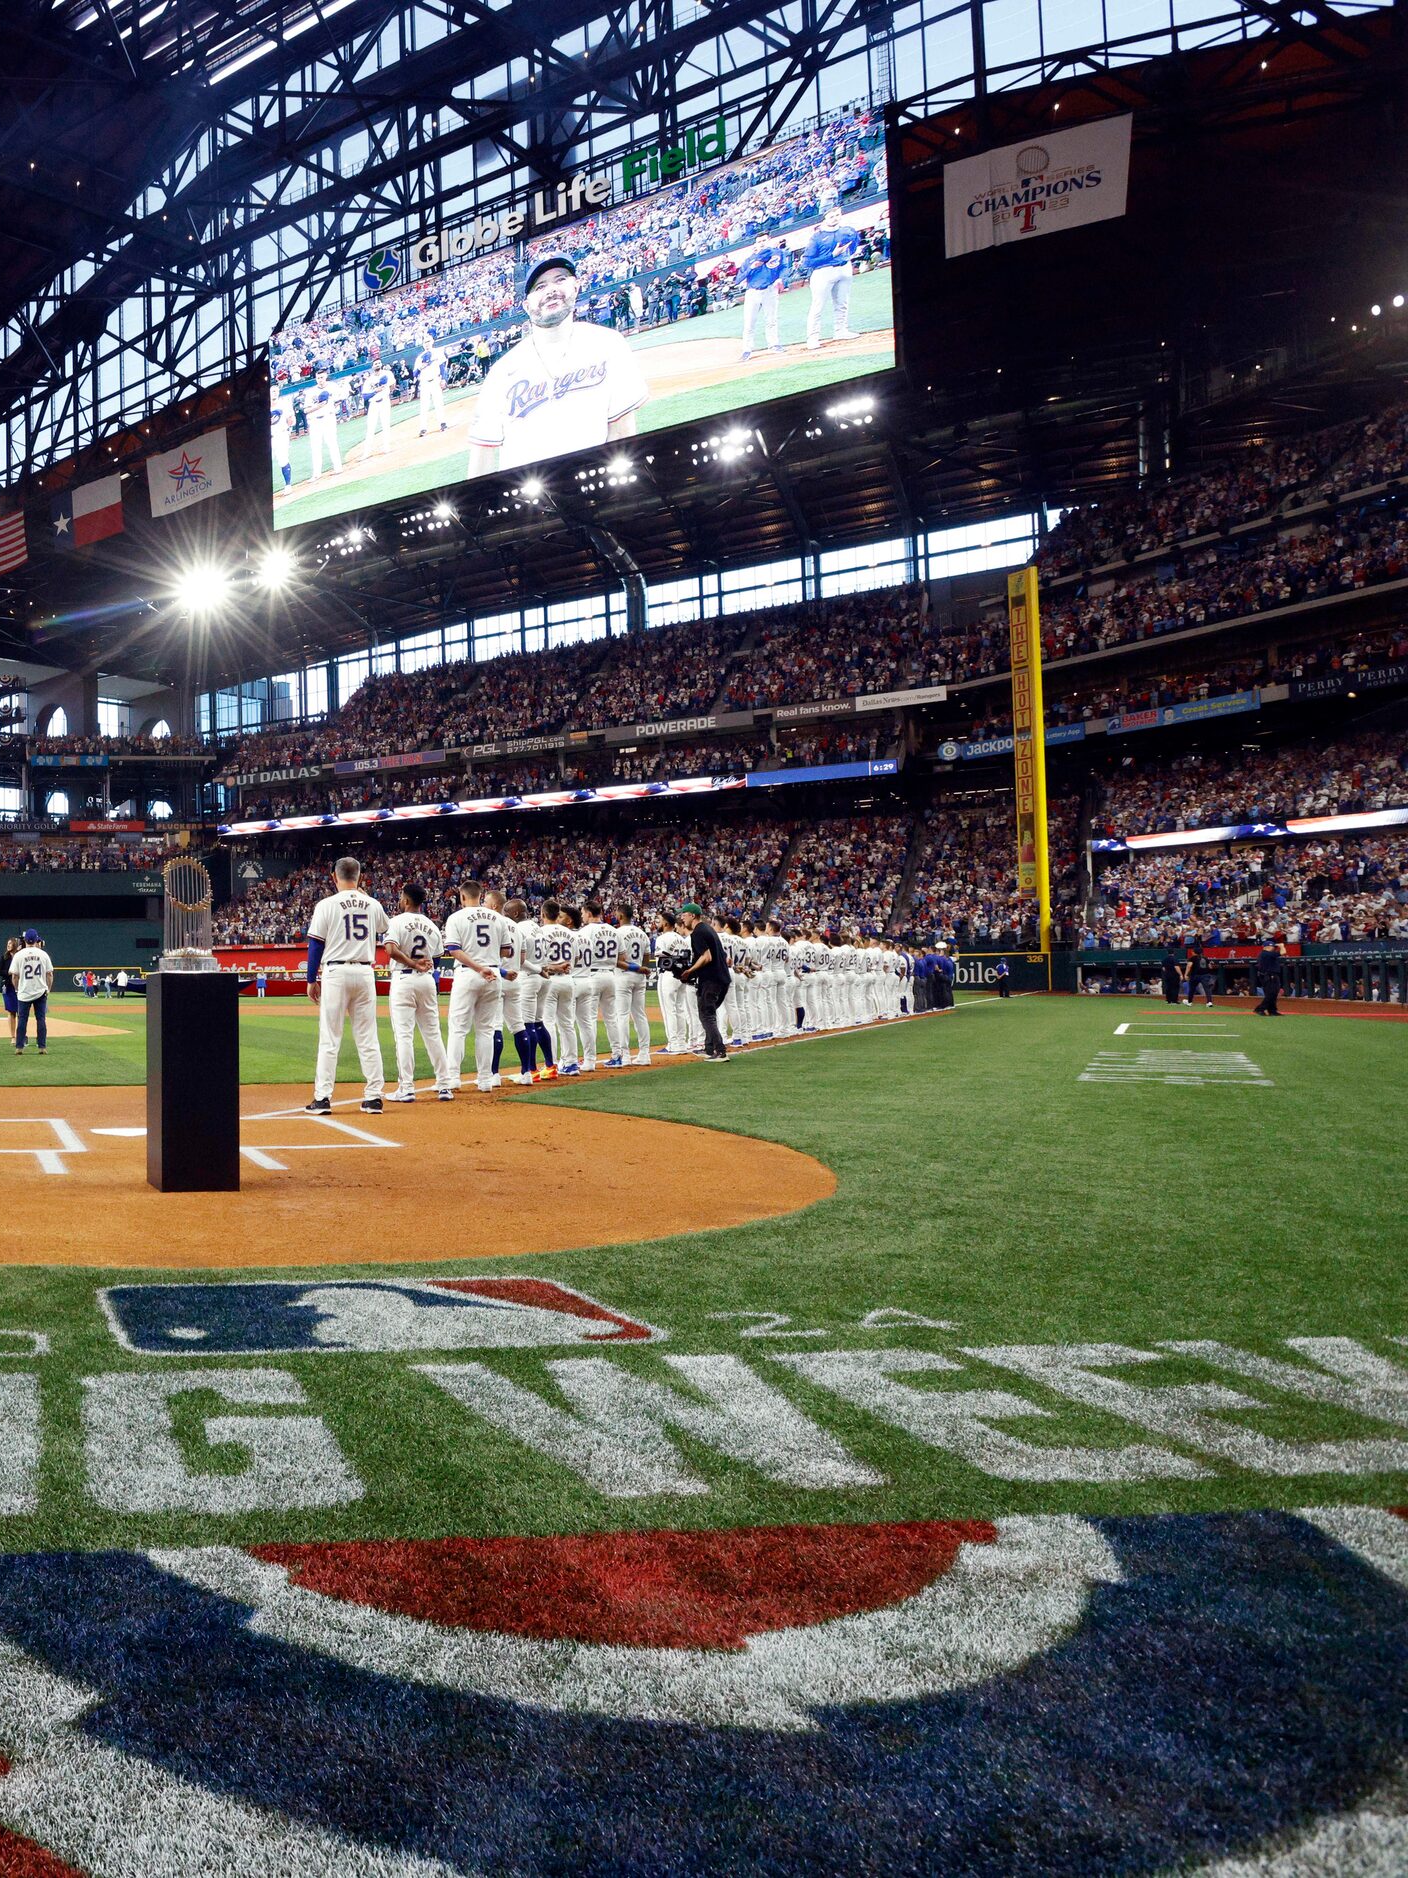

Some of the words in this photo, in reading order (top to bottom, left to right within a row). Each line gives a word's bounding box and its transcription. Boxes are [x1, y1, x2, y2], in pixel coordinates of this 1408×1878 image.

[974, 183, 1020, 201] WORLD
[1045, 164, 1095, 184] SERIES
[411, 209, 525, 271] Globe
[534, 176, 611, 226] Life
[621, 117, 727, 192] Field
[967, 169, 1102, 218] CHAMPIONS
[1048, 197, 1070, 211] 23
[506, 357, 609, 420] Rangers
[164, 480, 213, 507] ARLINGTON
[1015, 607, 1025, 660] THE
[1357, 665, 1408, 683] PERRY
[1298, 677, 1344, 693] PERRY
[776, 708, 798, 718] Real
[799, 705, 820, 715] fans
[821, 701, 852, 712] know.
[1017, 675, 1027, 727] HOT
[1121, 711, 1158, 722] BAKER
[635, 715, 716, 738] POWERADE
[1067, 728, 1081, 737] App
[472, 743, 501, 755] PGL
[353, 759, 379, 771] 105.3
[873, 763, 894, 772] 6:29
[236, 774, 258, 786] UT
[260, 765, 321, 783] DALLAS
[1020, 742, 1030, 812] ZONE
[33, 822, 58, 831] GOLD
[156, 823, 203, 831] PLUCKERS
[339, 898, 371, 911] BOCHY
[466, 912, 497, 924] SEAGER
[342, 913, 369, 942] 15
[476, 924, 491, 948] 5
[594, 931, 617, 940] CARTER
[410, 935, 428, 960] 2
[548, 940, 572, 962] 36
[594, 939, 617, 959] 32
[631, 942, 640, 960] 3
[776, 948, 788, 962] 46
[818, 953, 830, 966] 30
[1026, 954, 1044, 964] 326
[23, 963, 42, 980] 24
